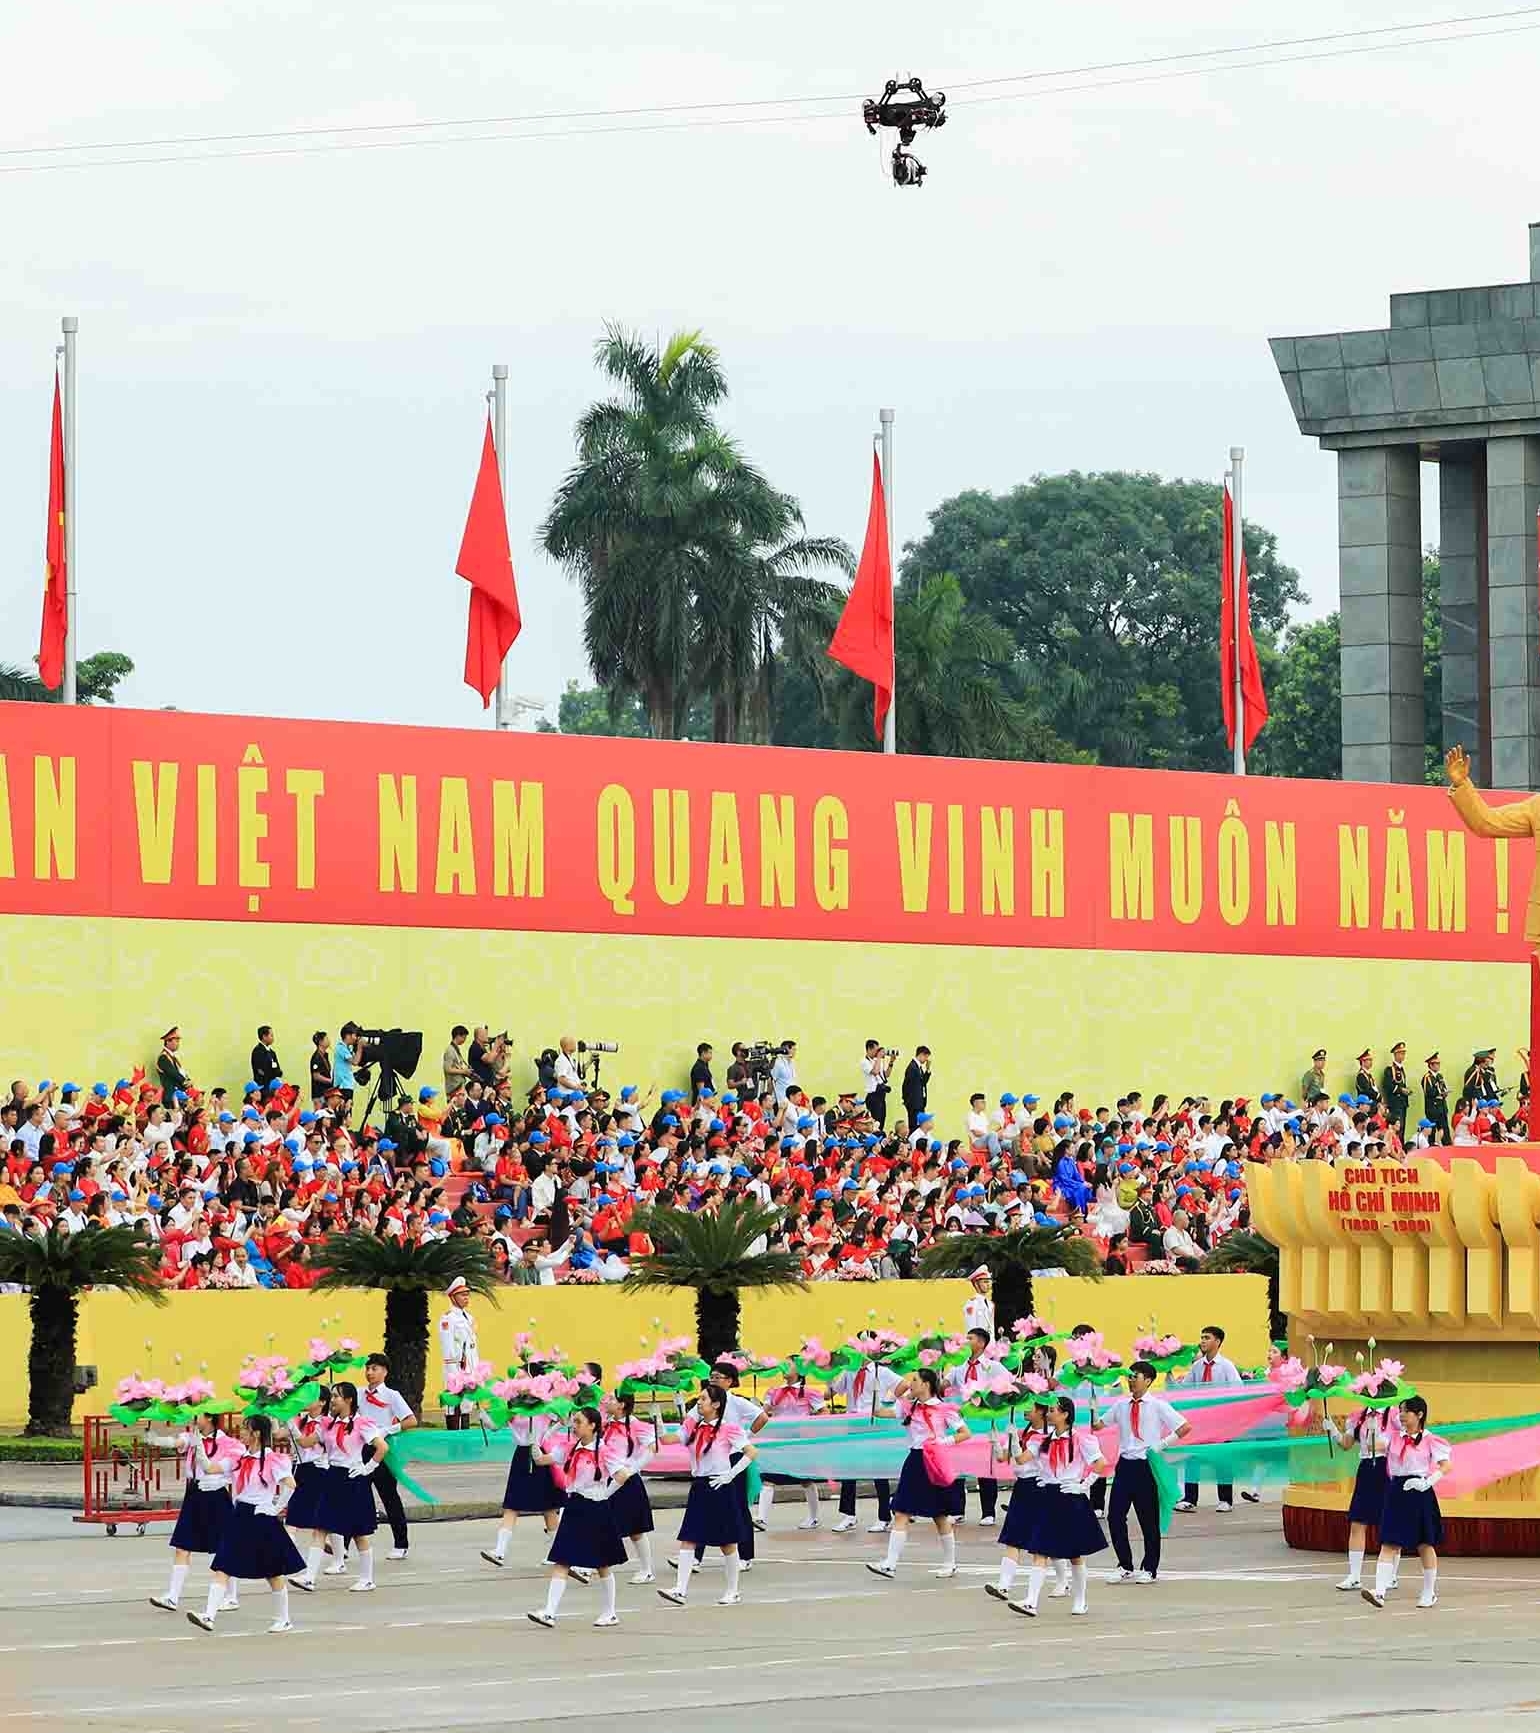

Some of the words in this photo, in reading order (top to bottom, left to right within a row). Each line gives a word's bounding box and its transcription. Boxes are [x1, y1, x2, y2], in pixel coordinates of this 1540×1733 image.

[132, 743, 325, 912] VIỆT
[378, 774, 545, 898] NAM
[597, 783, 849, 916] QUANG
[895, 800, 1065, 918] VINH
[1109, 798, 1298, 926] MUÔN
[1337, 808, 1467, 934] NĂM
[1328, 1183, 1352, 1212] HỒ
[1355, 1186, 1385, 1213] CHÍ
[1391, 1190, 1441, 1213] MINH
